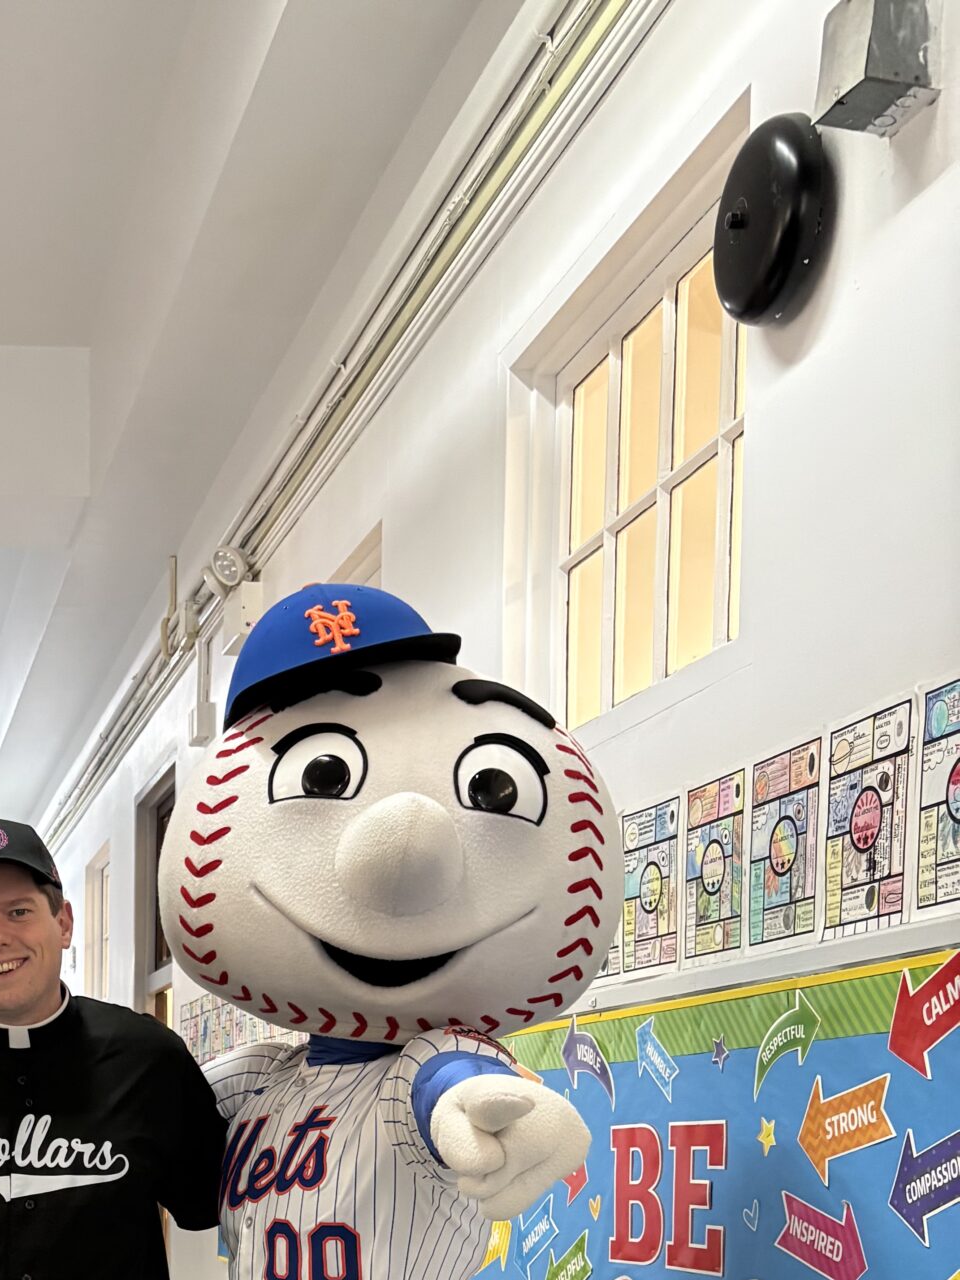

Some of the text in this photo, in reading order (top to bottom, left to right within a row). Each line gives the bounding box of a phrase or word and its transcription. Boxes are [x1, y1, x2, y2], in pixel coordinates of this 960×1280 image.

[922, 974, 960, 1026] CALM
[576, 1043, 602, 1075] VISIBLE
[646, 1041, 671, 1082] HUMBLE
[761, 1024, 806, 1066] RESPECTFUL
[824, 1100, 878, 1140] STRONG
[610, 1120, 728, 1277] BE
[522, 1214, 551, 1257] AMAZING
[789, 1214, 844, 1263] INSPIRED
